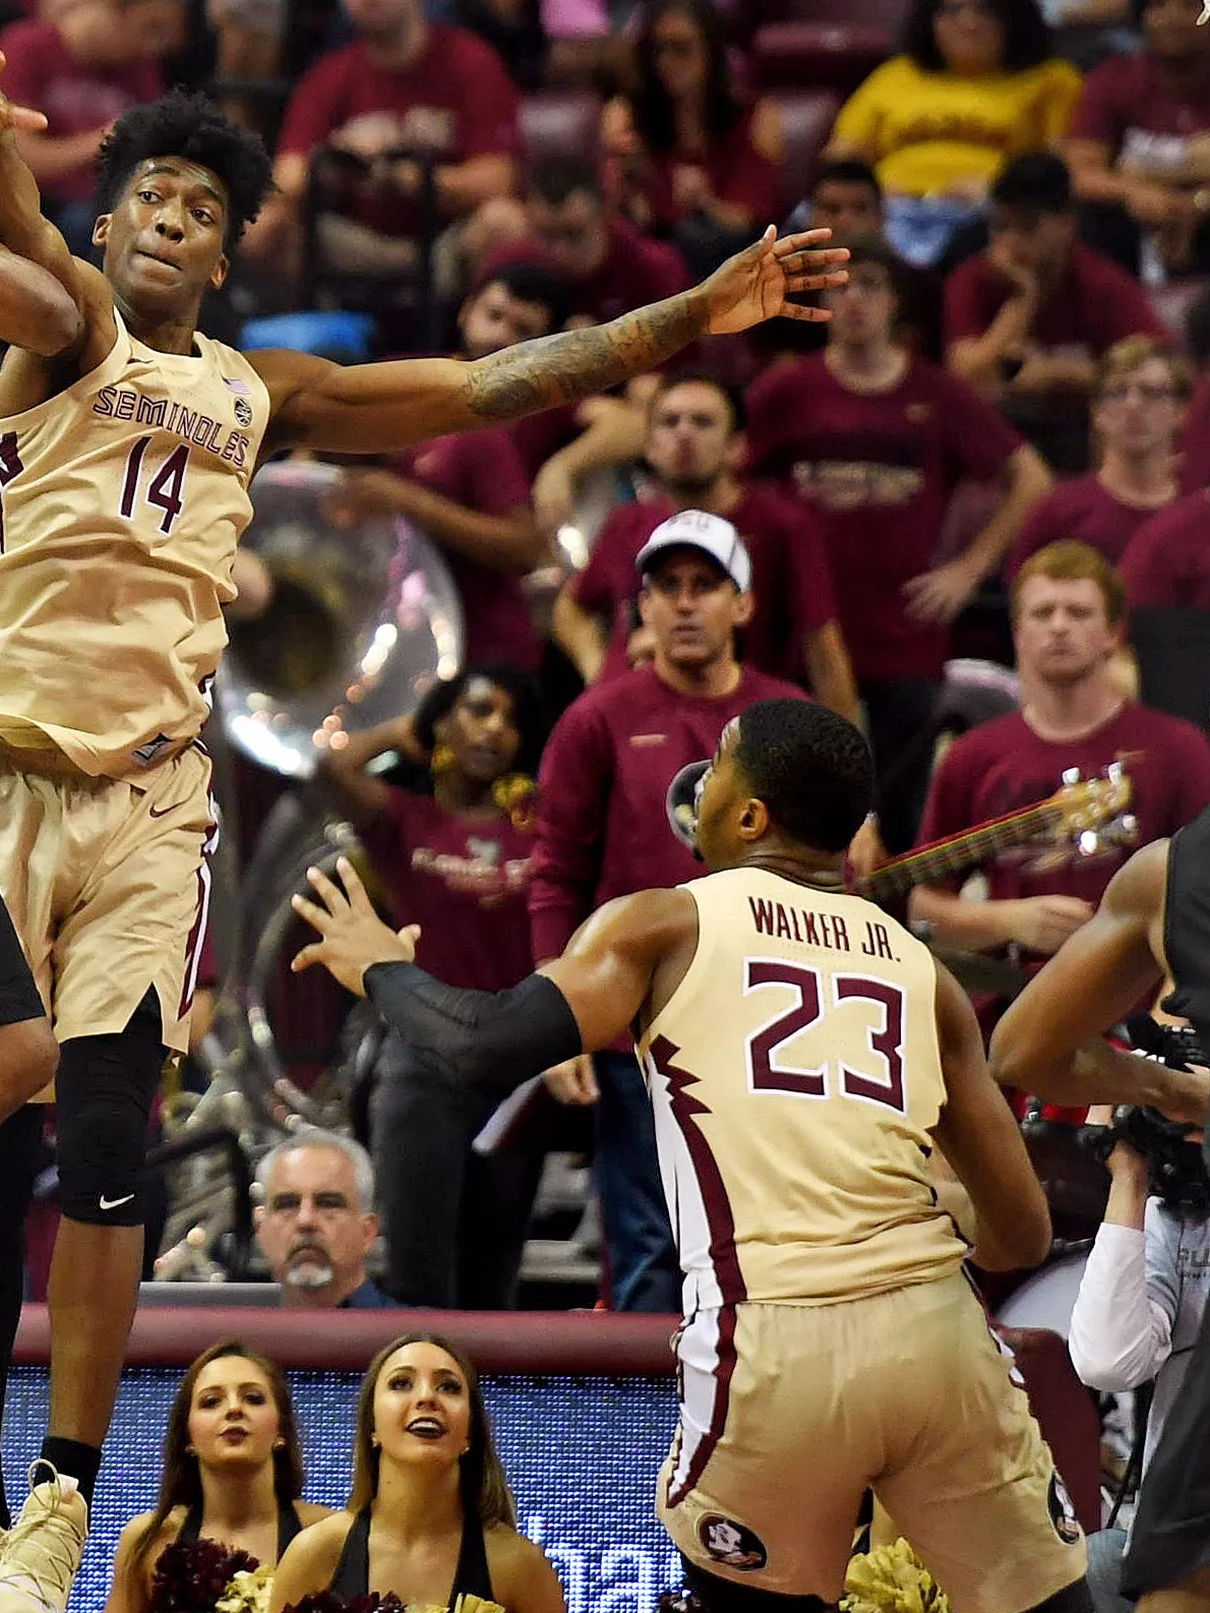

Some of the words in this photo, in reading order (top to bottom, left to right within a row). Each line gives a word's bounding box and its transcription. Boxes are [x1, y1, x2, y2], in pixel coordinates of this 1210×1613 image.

[93, 386, 250, 467] SEMINOLES
[118, 435, 191, 537] 14
[748, 896, 851, 952] WALKER
[861, 920, 902, 962] JR.
[742, 956, 908, 1120] 23
